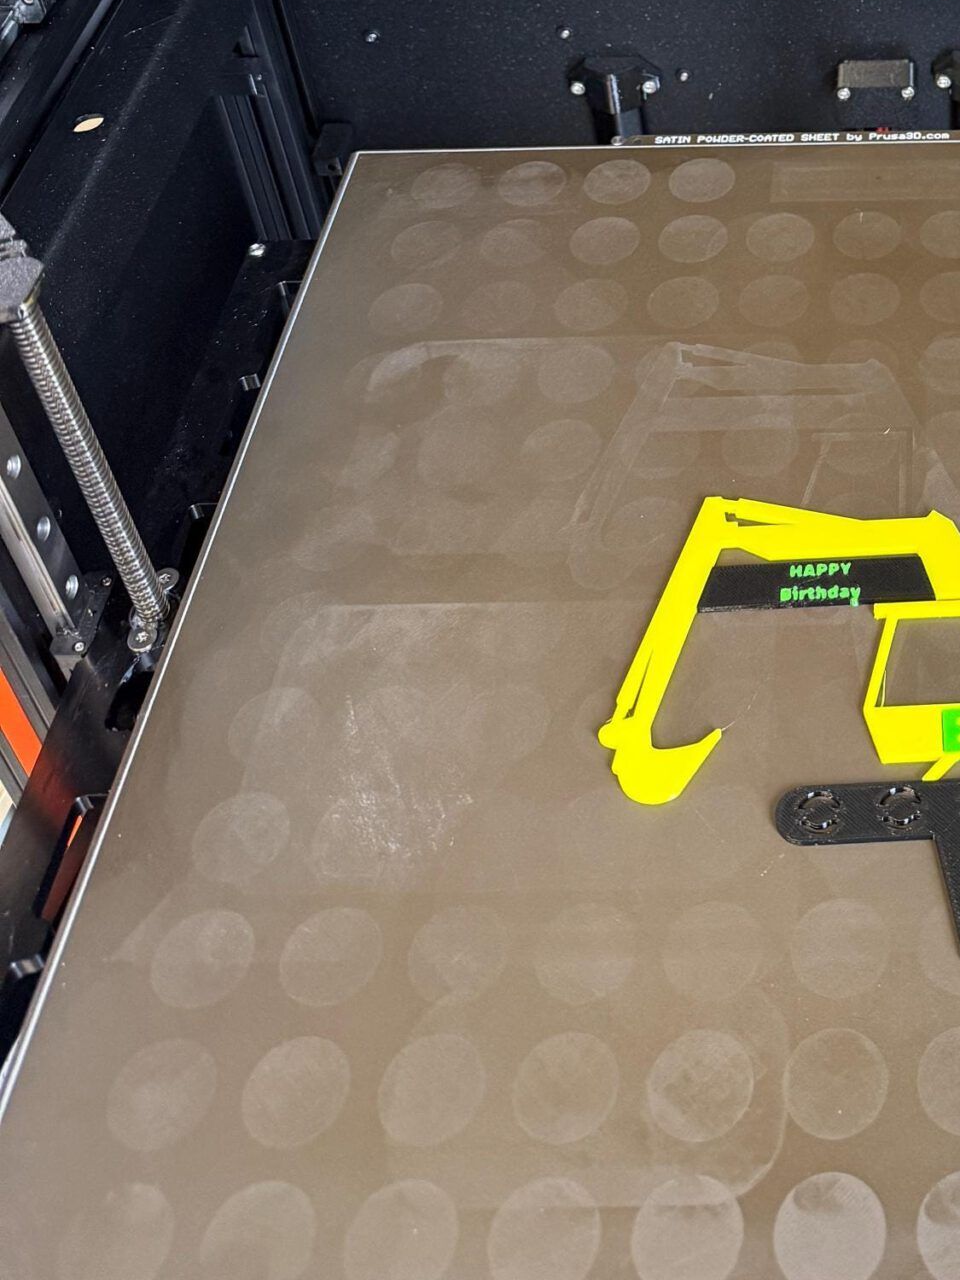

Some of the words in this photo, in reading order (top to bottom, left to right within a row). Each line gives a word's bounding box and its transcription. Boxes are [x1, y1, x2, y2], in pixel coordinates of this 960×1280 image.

[654, 136, 691, 144] SATIN
[697, 134, 795, 143] POWDER-COATED
[800, 133, 840, 142] SHEET
[846, 132, 863, 142] by
[868, 131, 950, 140] Prusa3D.com
[789, 562, 852, 578] HAPPY
[780, 585, 861, 608] Birthday
